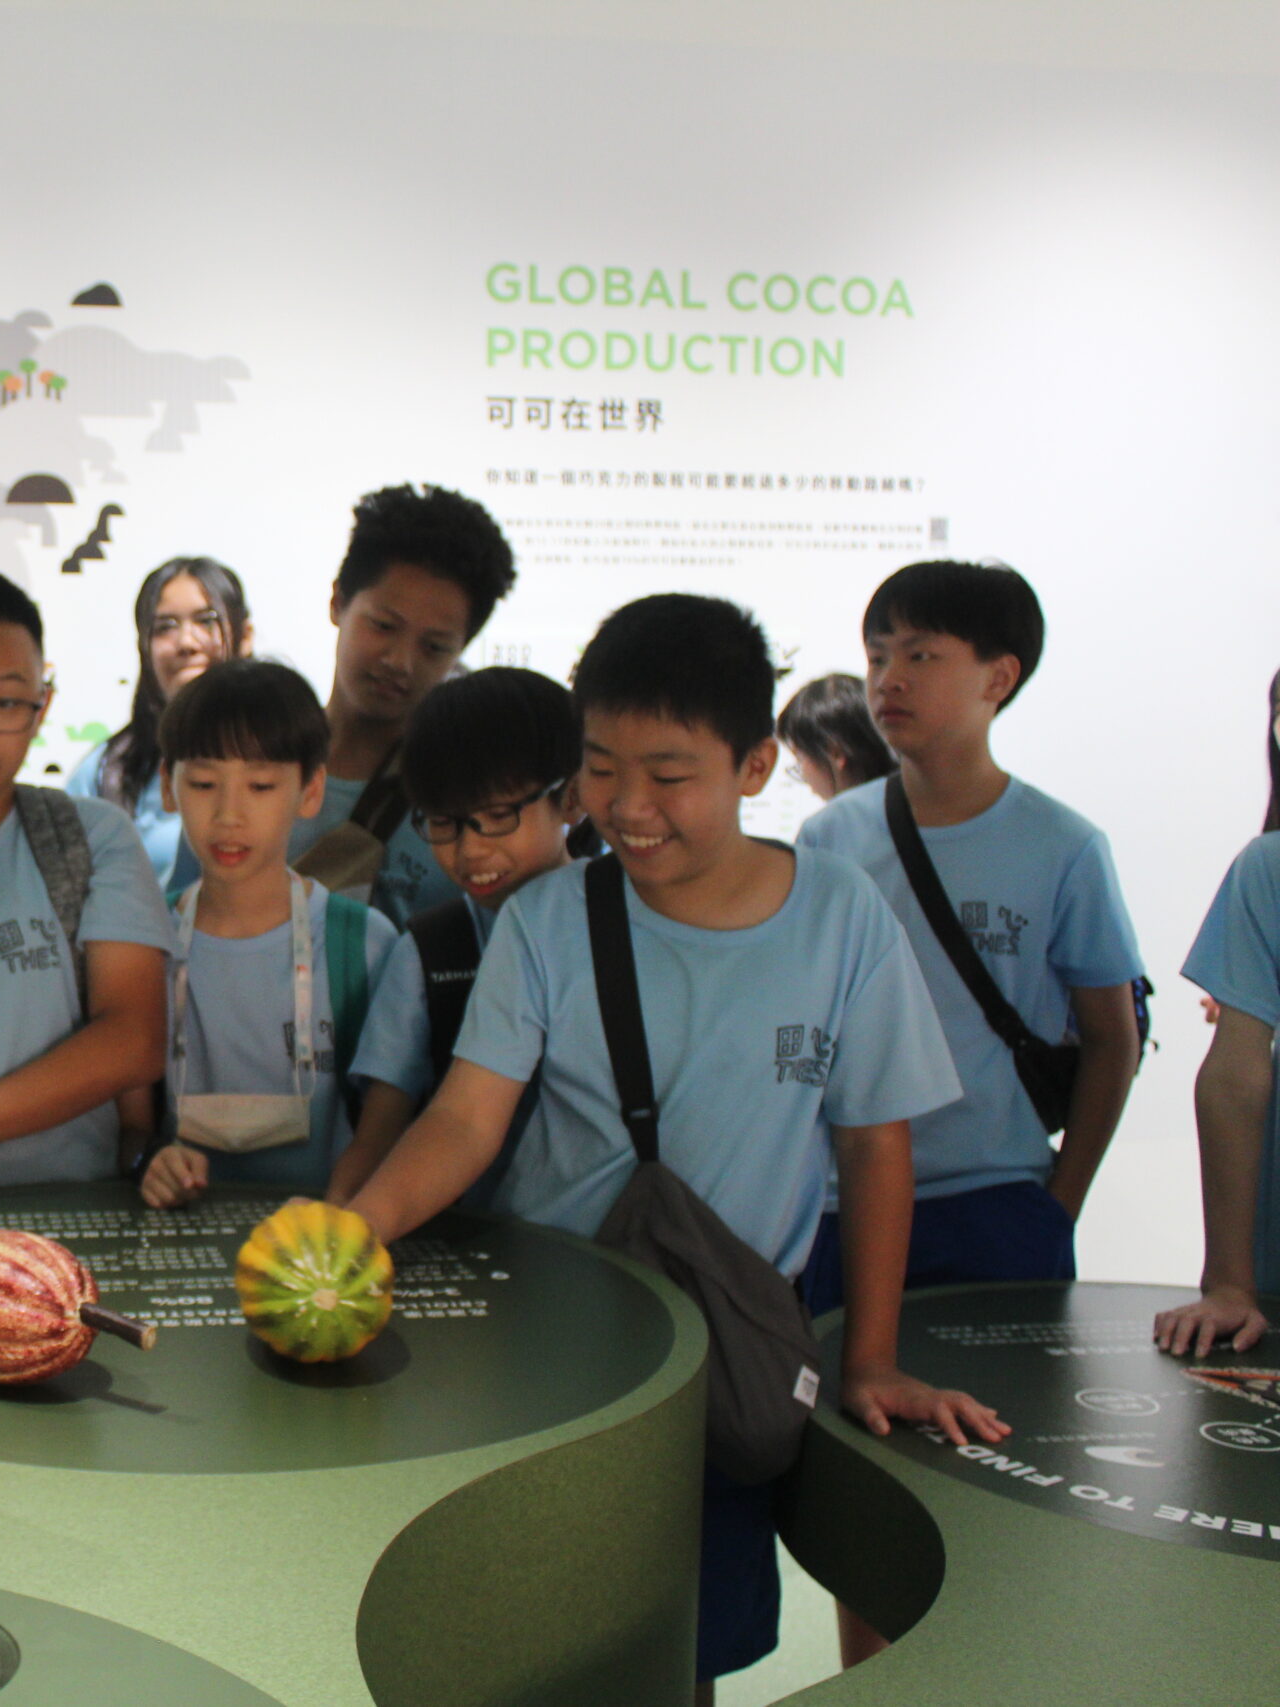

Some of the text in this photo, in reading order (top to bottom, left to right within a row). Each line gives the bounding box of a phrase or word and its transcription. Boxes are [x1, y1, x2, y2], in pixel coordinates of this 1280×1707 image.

[486, 263, 914, 318] GLOBAL COCOA
[486, 327, 845, 378] PRODUCTION
[486, 395, 665, 433] 可可在世界
[956, 1445, 1063, 1487] FIND
[1069, 1484, 1136, 1512] TO
